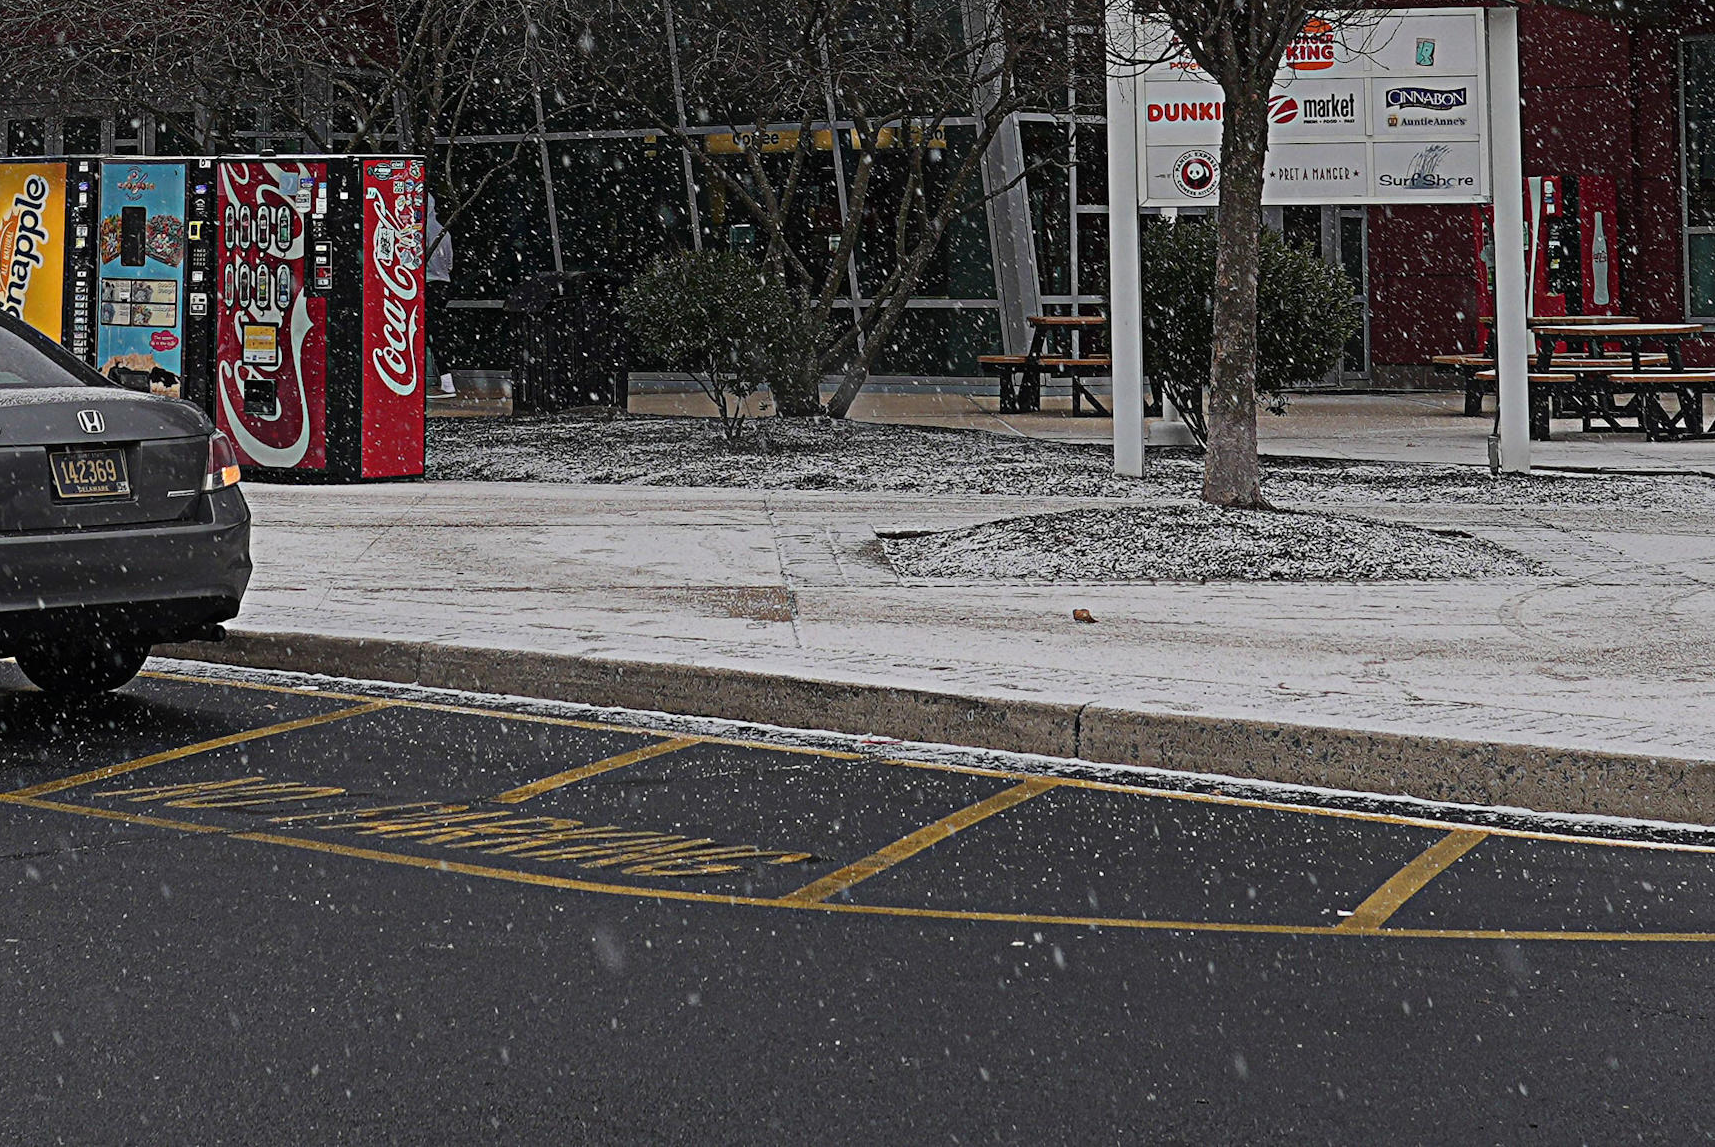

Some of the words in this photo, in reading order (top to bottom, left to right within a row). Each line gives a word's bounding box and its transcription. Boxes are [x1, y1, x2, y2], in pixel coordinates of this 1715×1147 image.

[1288, 34, 1334, 45] URGER
[1285, 45, 1335, 61] KING
[1303, 93, 1355, 118] market
[1387, 89, 1464, 106] CINNABON
[1147, 102, 1226, 122] DUNKI
[733, 132, 780, 146] Coee
[1175, 153, 1193, 172] PANDA
[1194, 152, 1219, 172] EXPRESS
[1279, 168, 1300, 181] PRET
[1303, 168, 1309, 180] A
[1312, 167, 1351, 181] MANGER
[1379, 172, 1421, 187] Surf
[1422, 173, 1474, 187] Shore
[60, 458, 118, 485] 142369
[76, 484, 111, 493] DELAWARE
[92, 776, 347, 809] NO
[265, 801, 814, 878] PARKING
